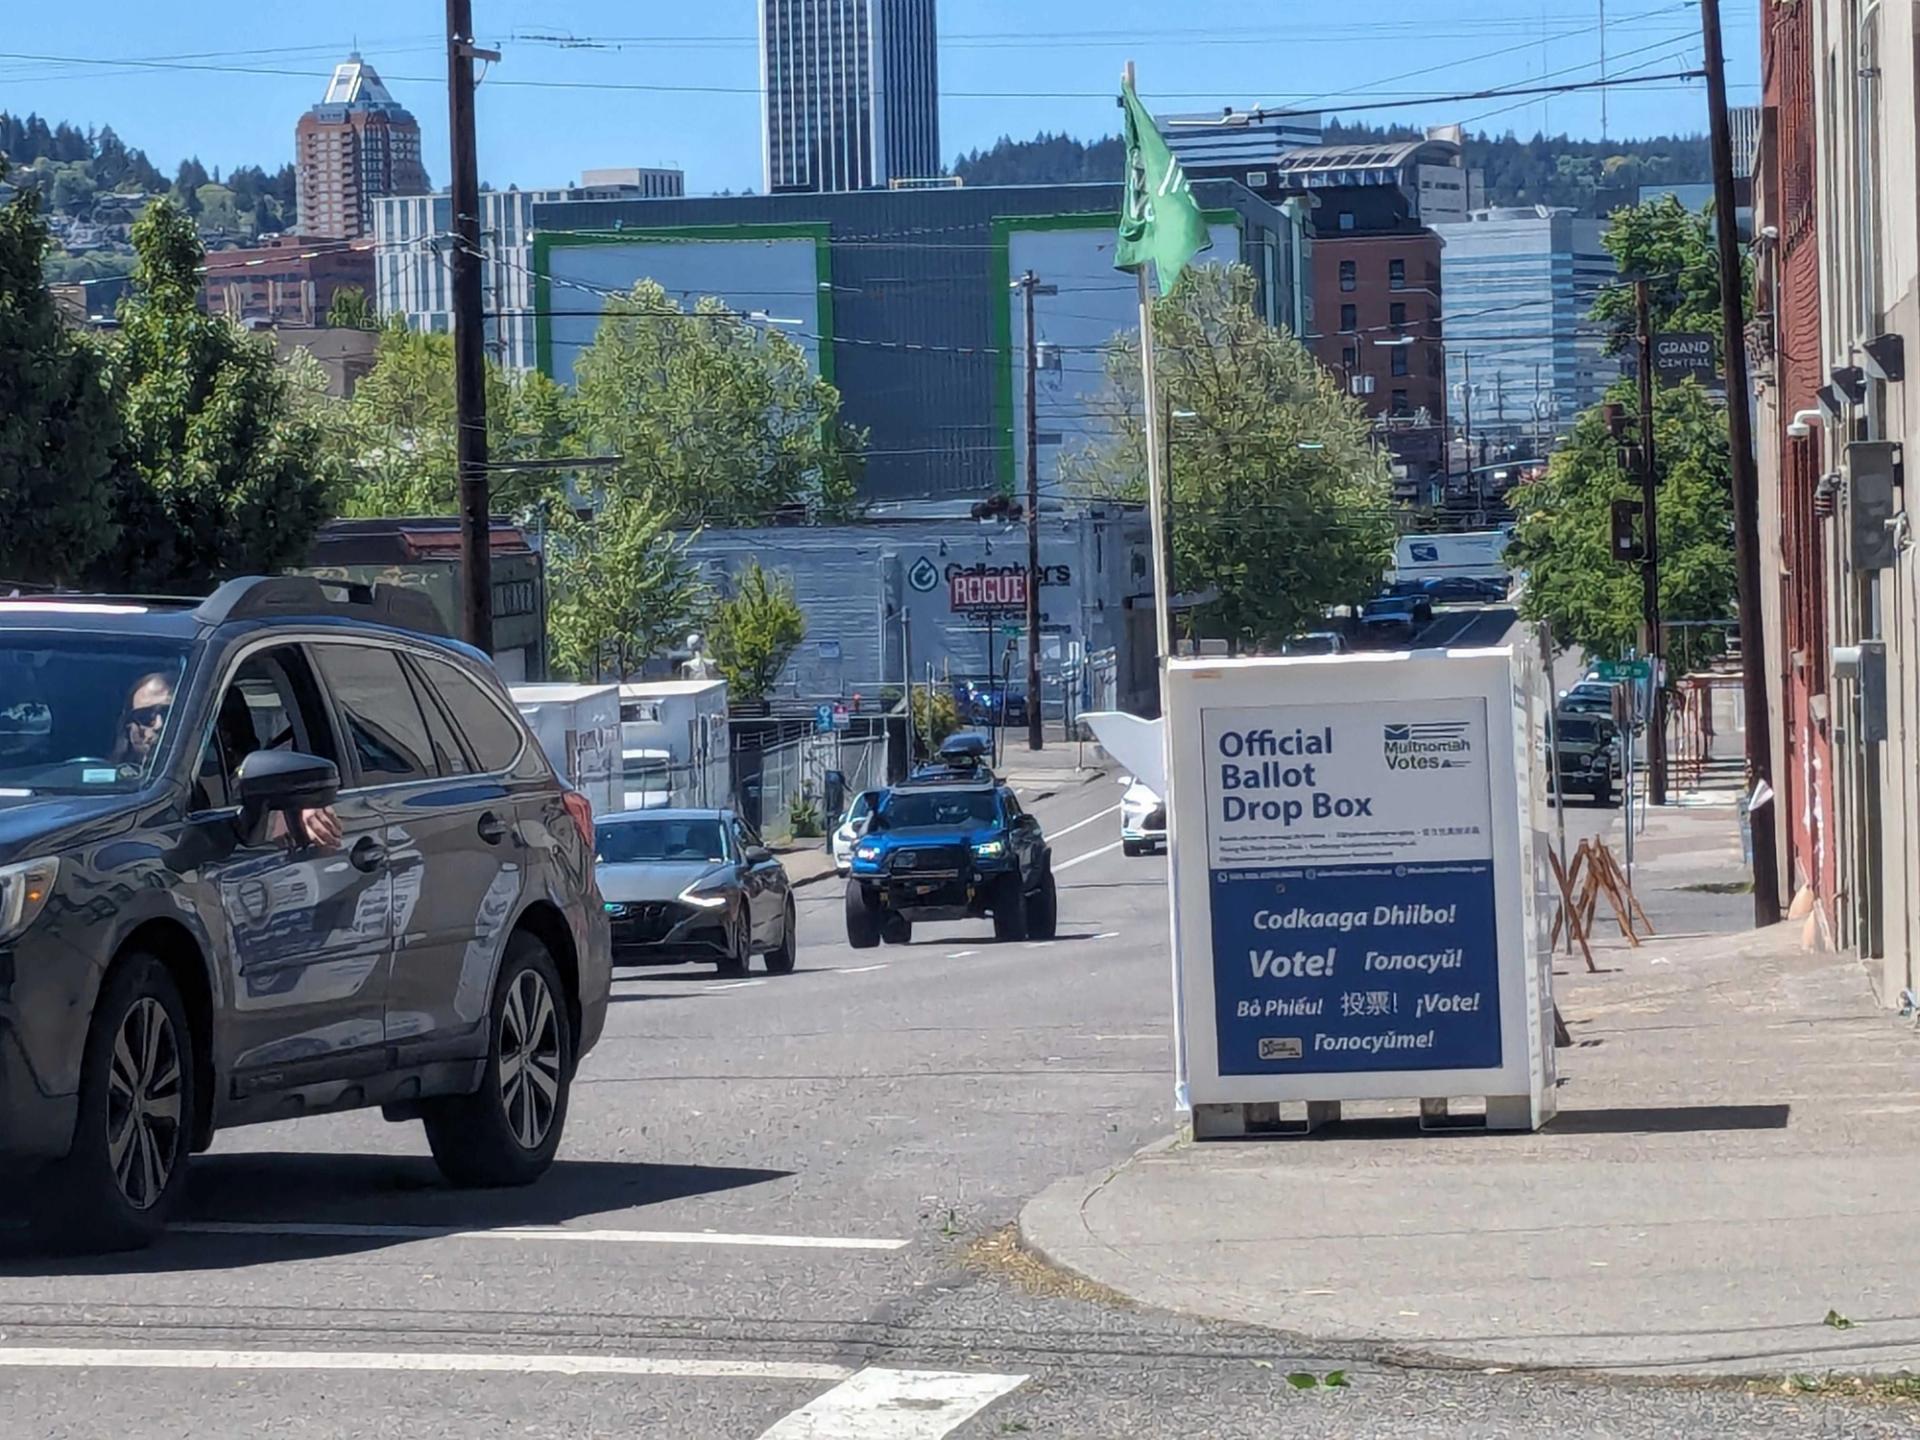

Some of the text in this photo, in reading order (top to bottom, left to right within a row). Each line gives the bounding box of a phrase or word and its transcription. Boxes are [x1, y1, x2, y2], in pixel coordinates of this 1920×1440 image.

[1658, 341, 1710, 355] GRAND
[954, 575, 1026, 604] ROGUE
[1219, 727, 1333, 758] Official
[1221, 761, 1316, 790] Ballot
[1386, 755, 1440, 770] Votes
[1223, 793, 1373, 826] Drop Box
[1254, 908, 1367, 932] Codkaaga
[1249, 948, 1337, 978] Vote!
[1416, 993, 1480, 1018] ¡Vote!
